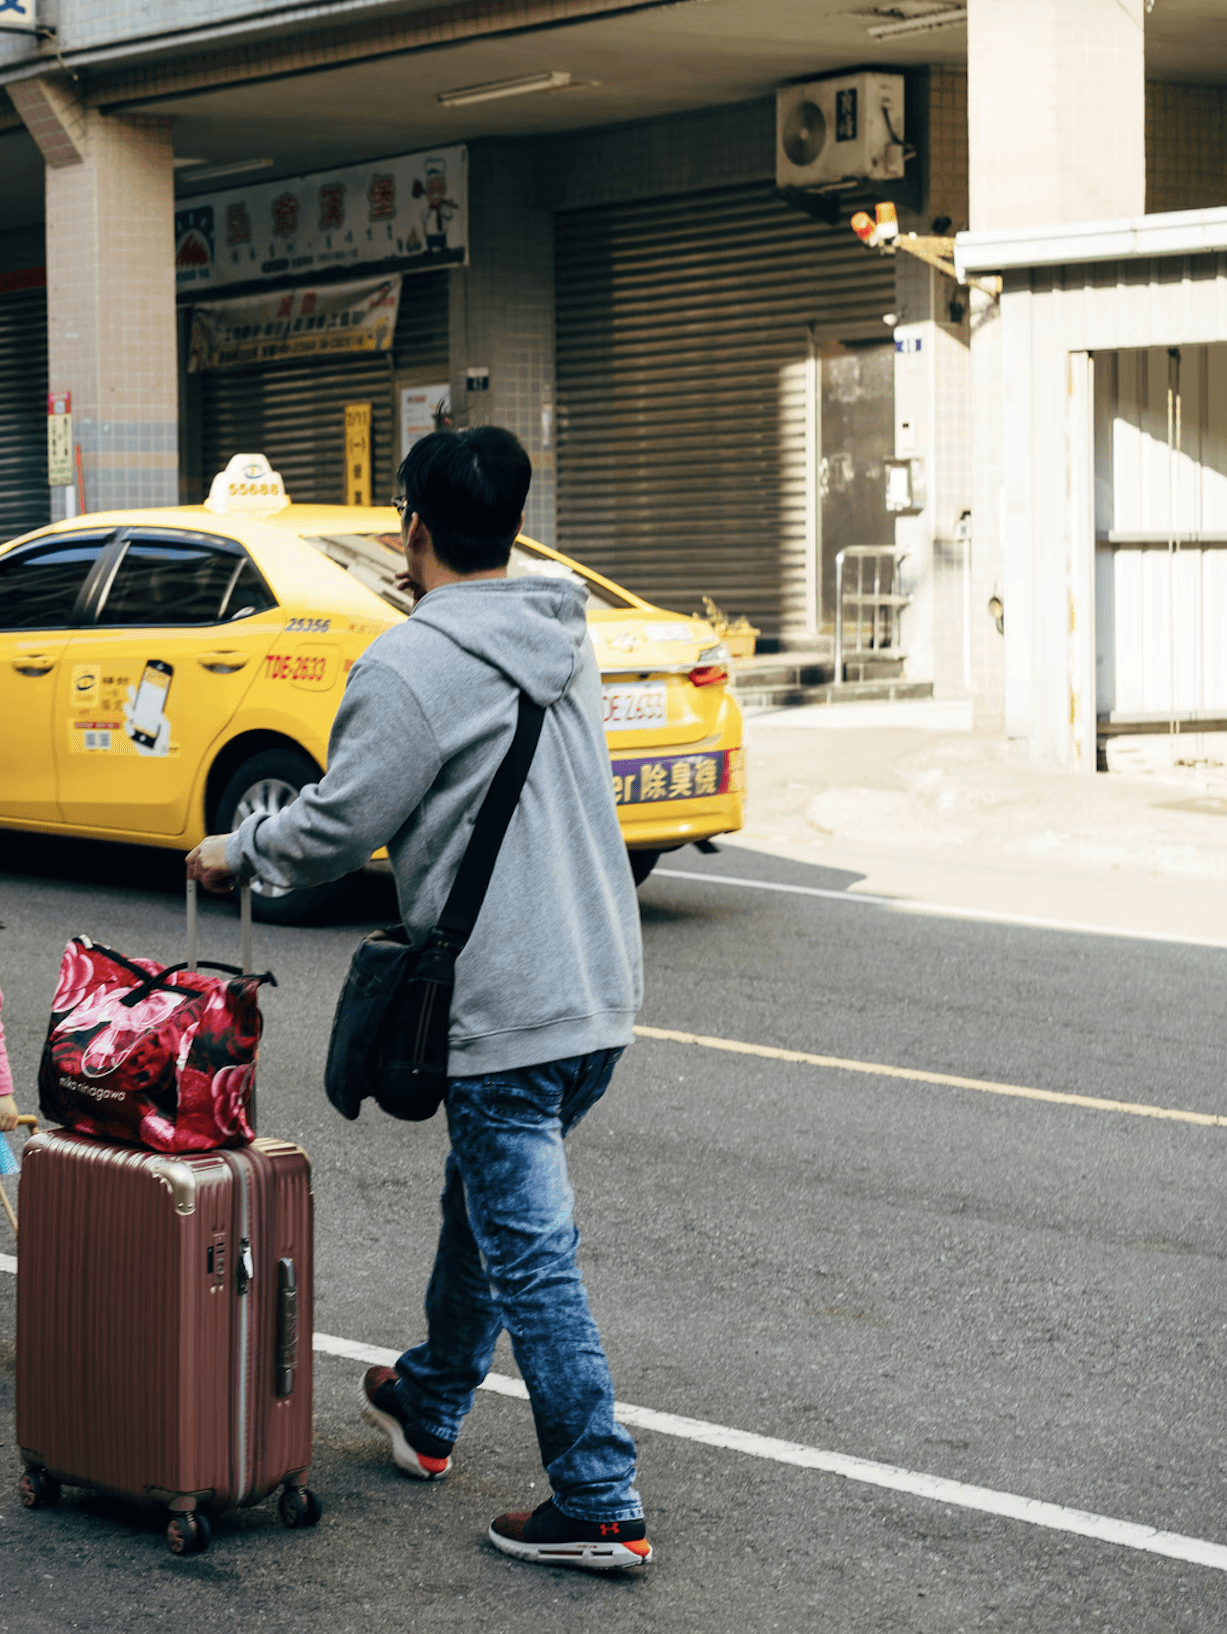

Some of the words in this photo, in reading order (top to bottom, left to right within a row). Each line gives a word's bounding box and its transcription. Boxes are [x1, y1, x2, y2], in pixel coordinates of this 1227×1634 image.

[229, 483, 280, 496] 55688
[285, 618, 332, 633] 25356
[265, 655, 326, 682] TDE-2633
